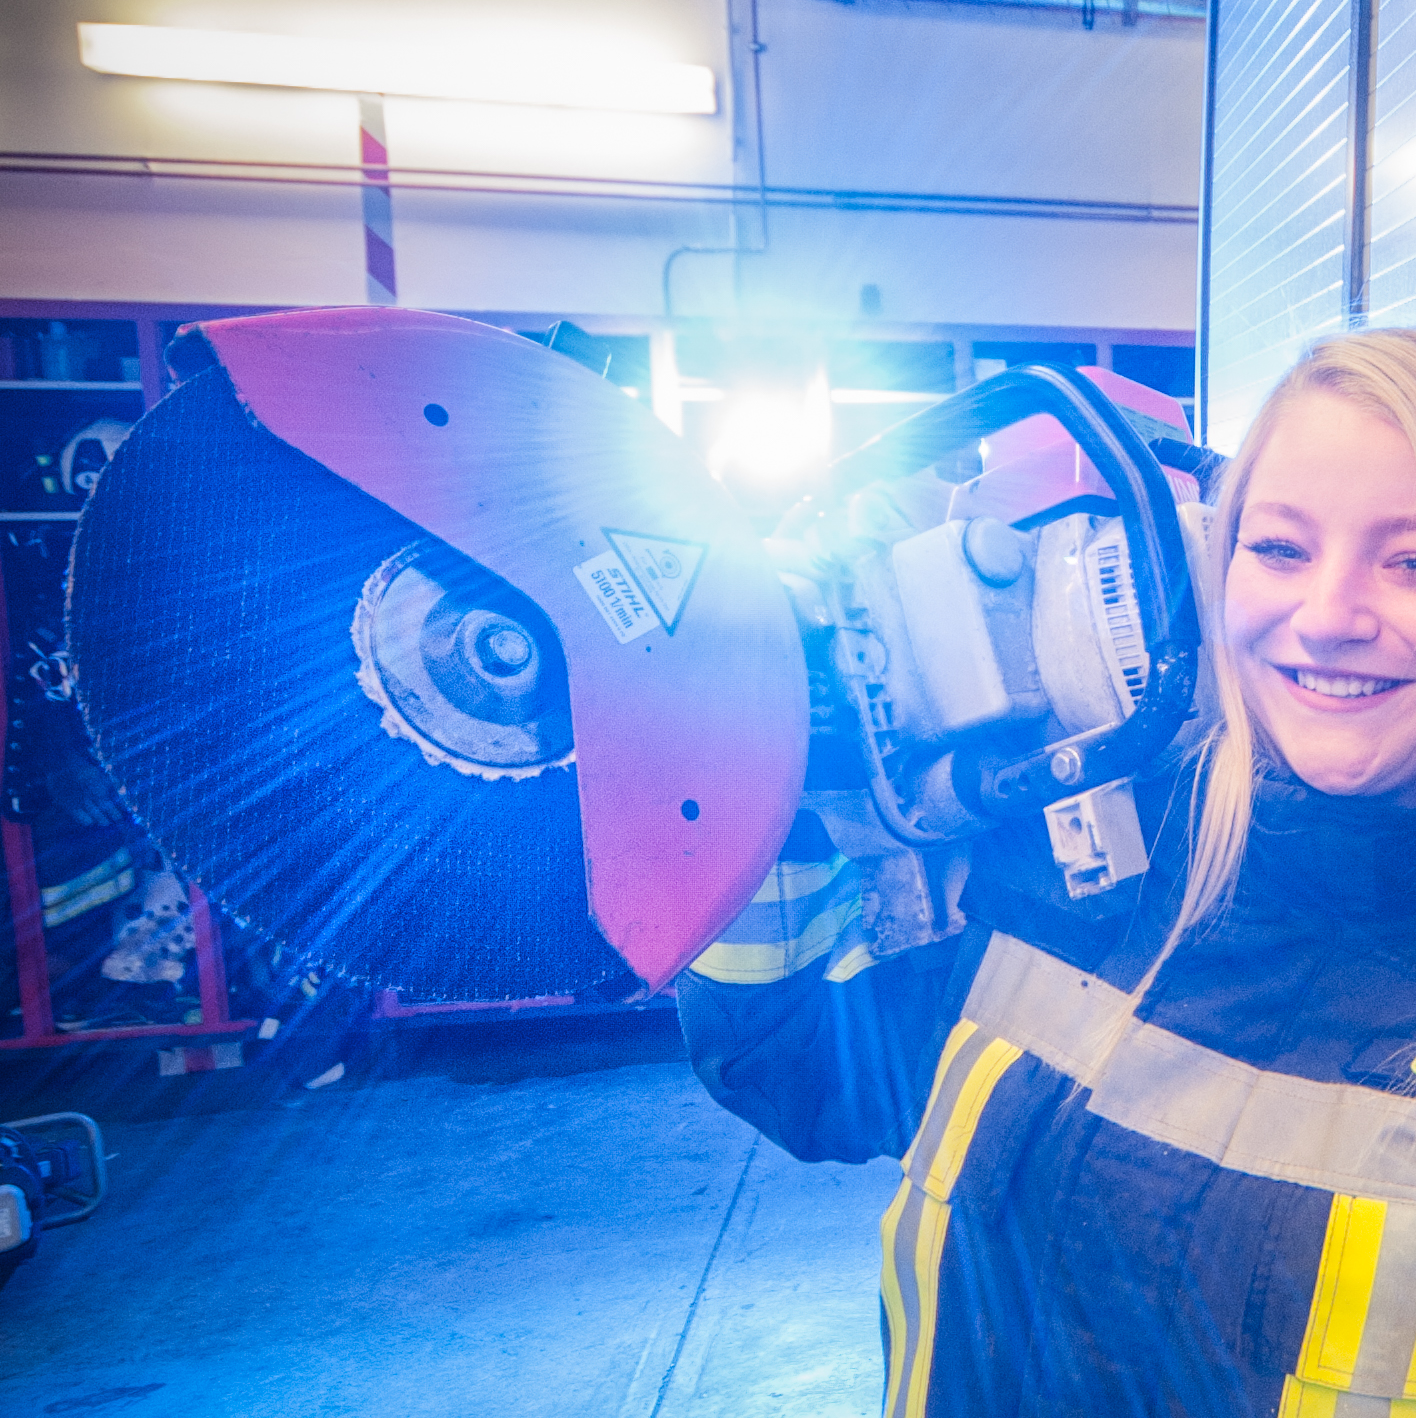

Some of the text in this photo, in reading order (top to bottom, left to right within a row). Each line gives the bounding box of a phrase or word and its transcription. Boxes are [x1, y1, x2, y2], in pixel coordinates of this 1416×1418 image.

[591, 570, 615, 598] 5100
[610, 596, 633, 629] 1/min
[607, 568, 644, 618] STIHL
